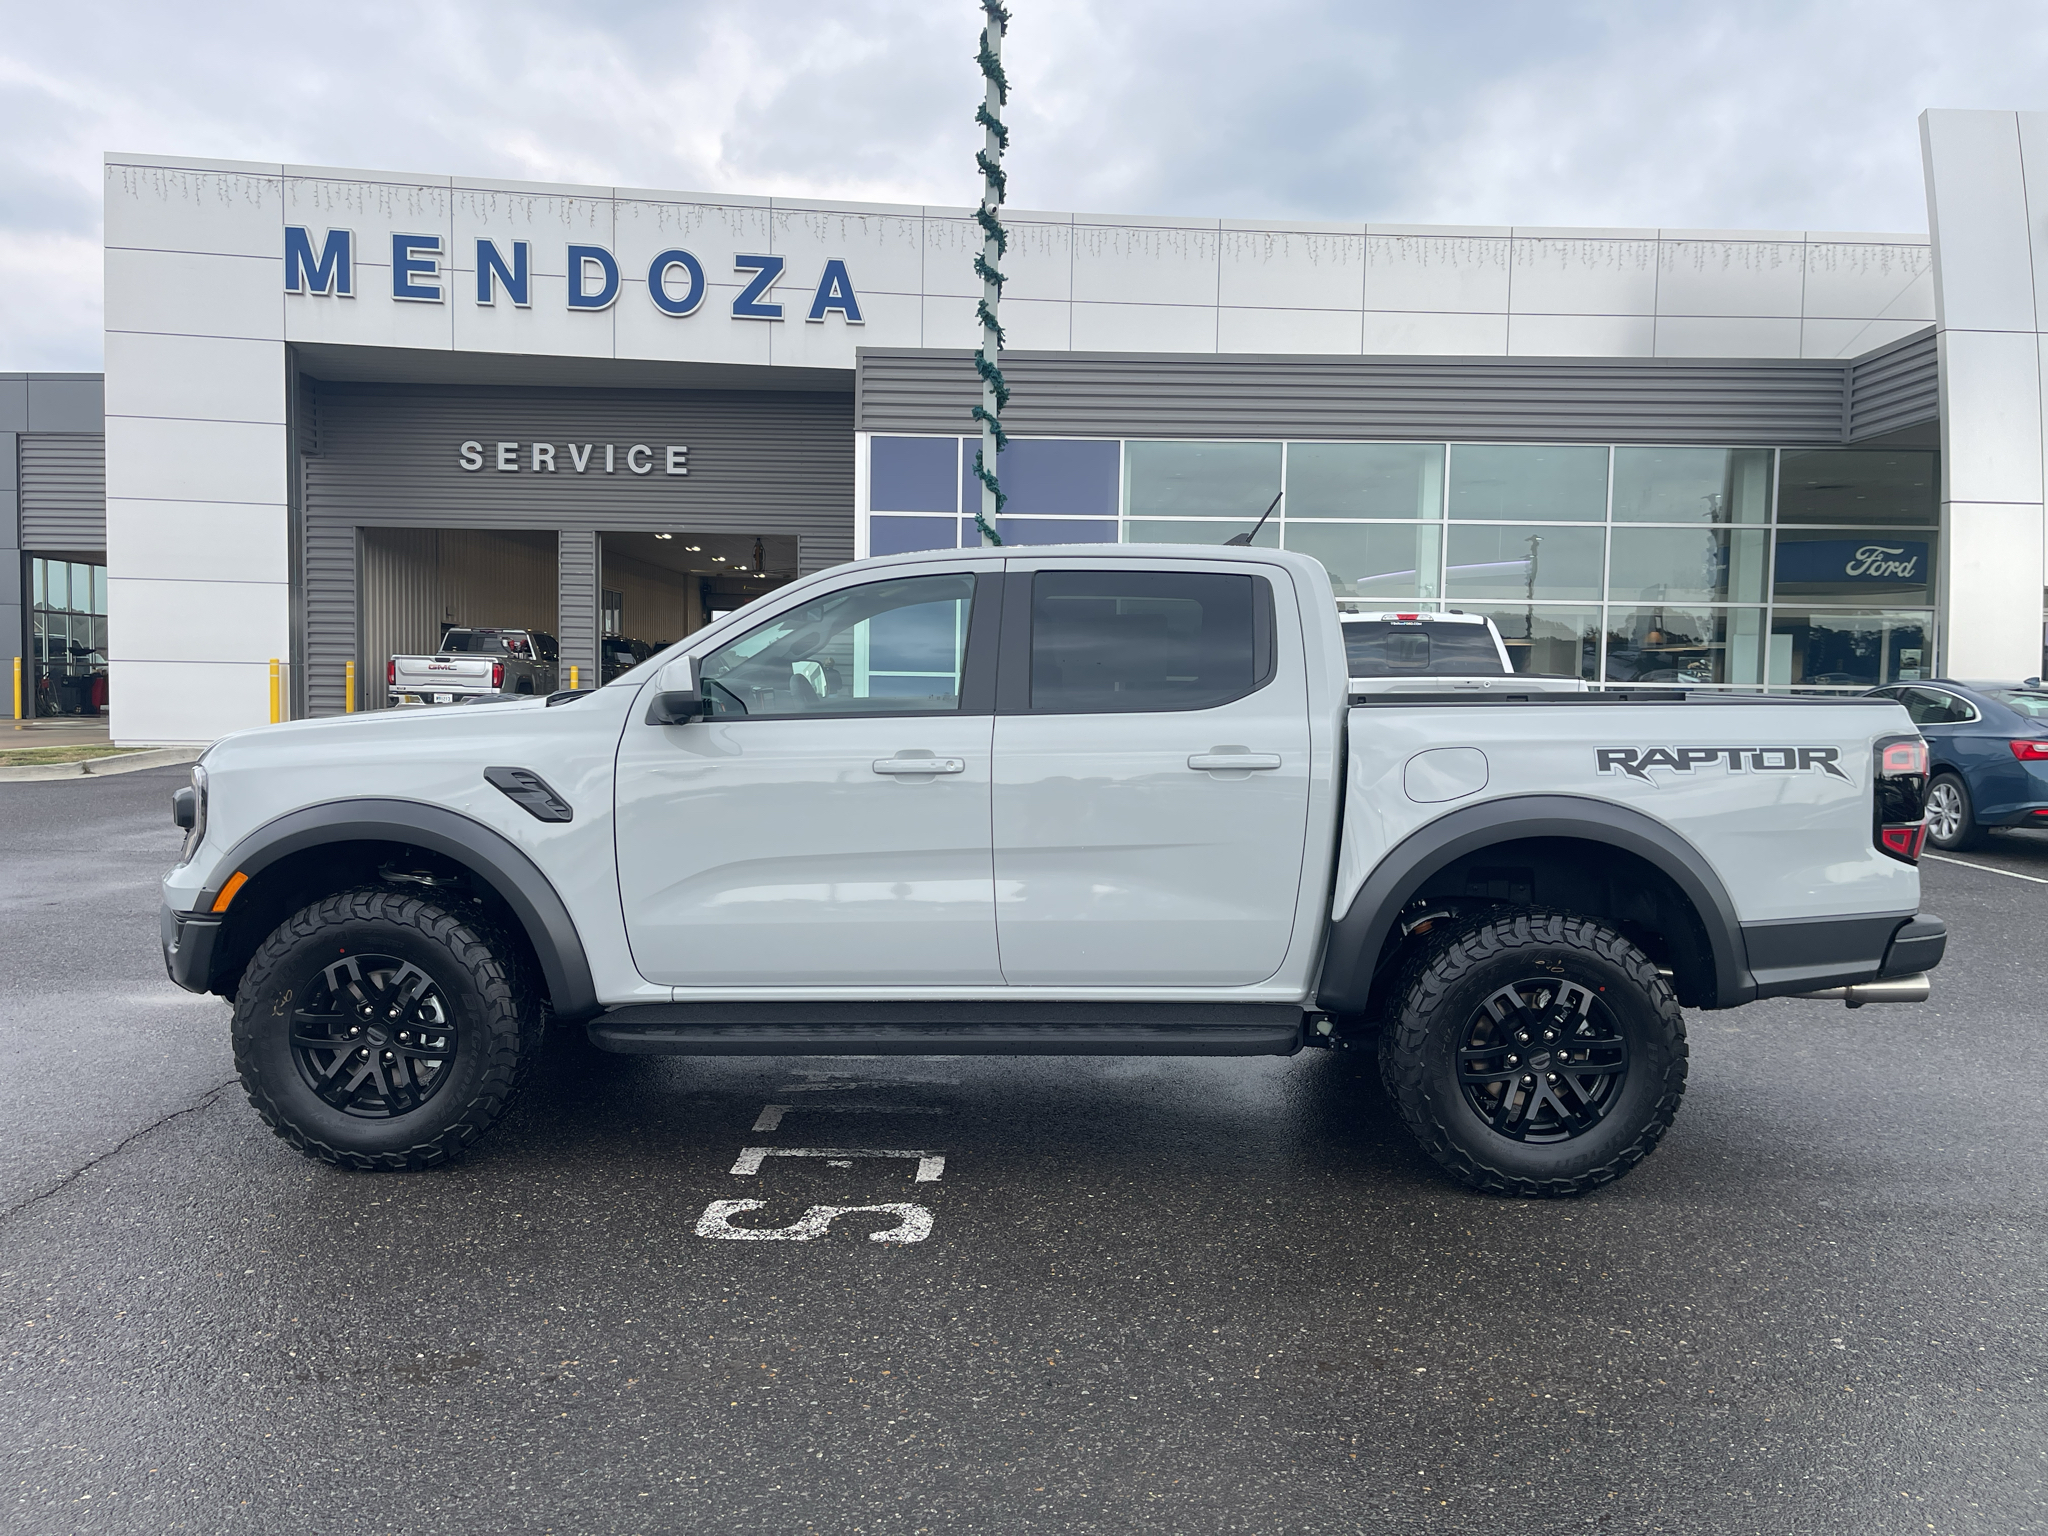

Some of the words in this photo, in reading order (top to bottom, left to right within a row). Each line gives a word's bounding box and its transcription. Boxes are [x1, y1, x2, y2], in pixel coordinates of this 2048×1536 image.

[282, 224, 866, 325] MENDOZA
[459, 440, 689, 476] SERVICE
[1845, 545, 1918, 578] Ford
[1594, 746, 1857, 789] RAPTOR
